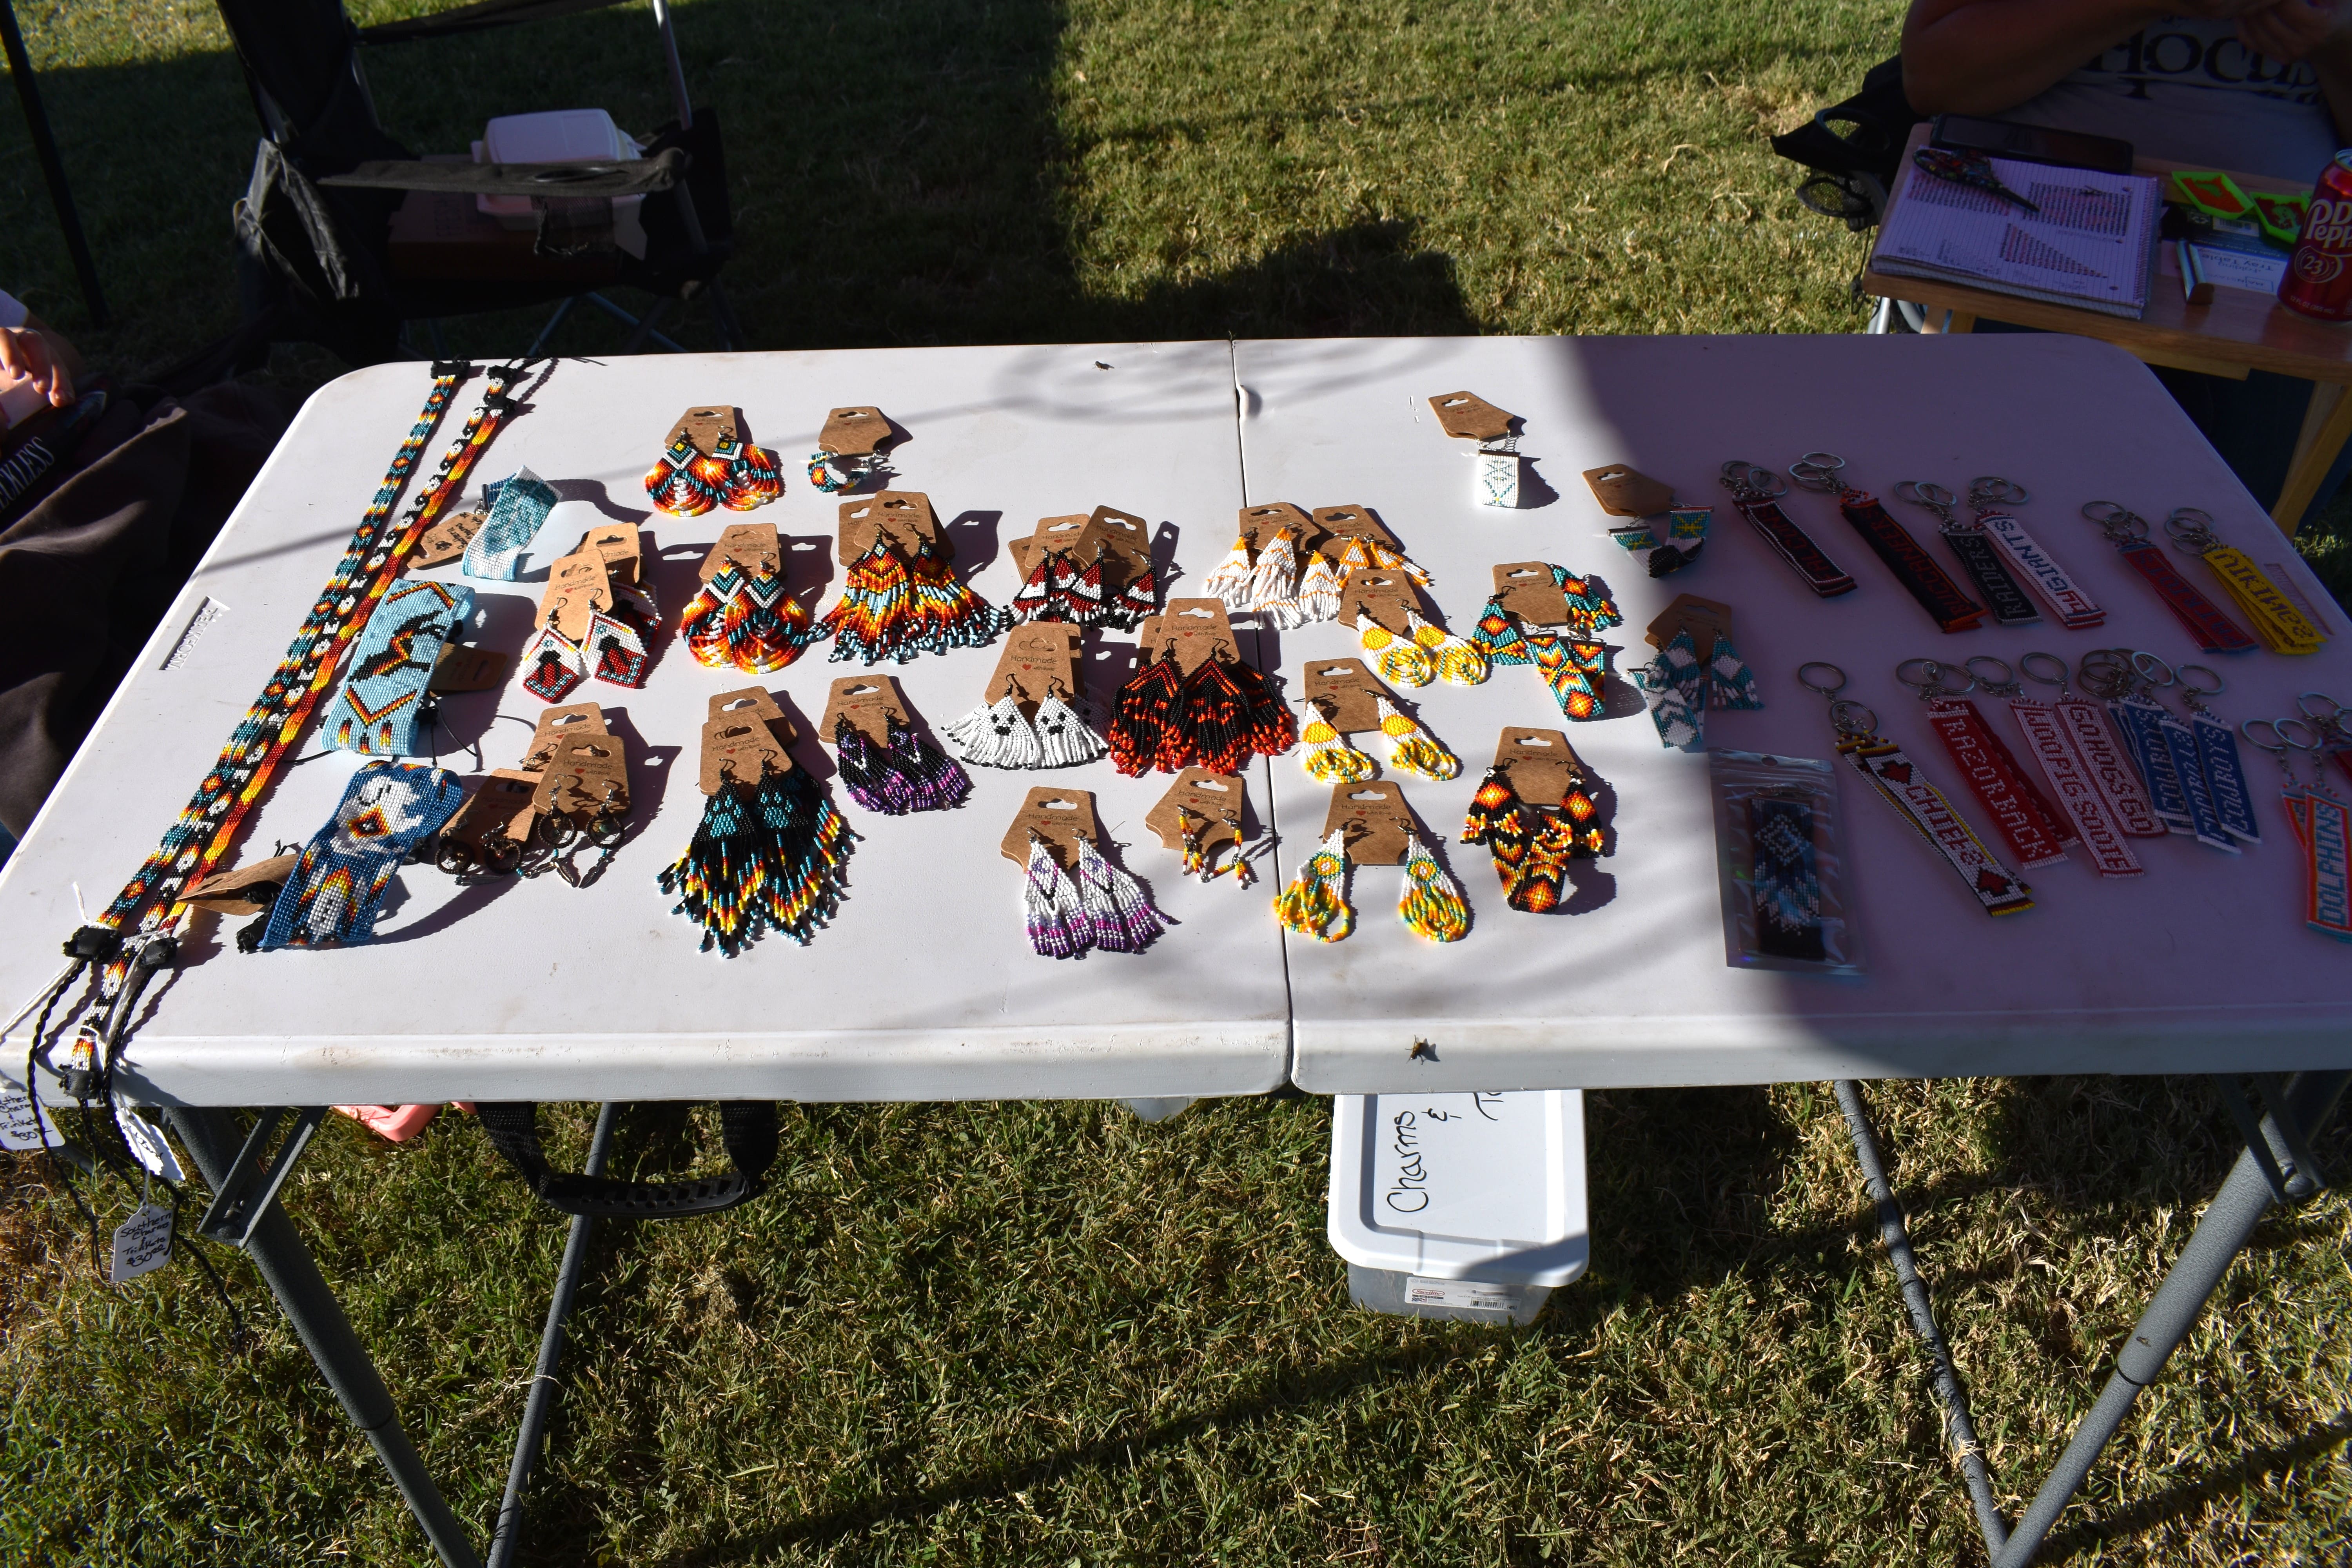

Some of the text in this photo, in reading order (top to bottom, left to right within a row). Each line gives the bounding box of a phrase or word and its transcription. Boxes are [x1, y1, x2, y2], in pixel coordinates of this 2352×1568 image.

[2330, 201, 2352, 225] D
[2304, 198, 2352, 248] Pepp
[2303, 255, 2323, 275] 23
[0, 437, 55, 510] ECKLESS
[1097, 525, 1138, 540] Handmade
[602, 549, 629, 558] ndmade
[1867, 506, 1976, 618] BUCCANEERS
[555, 575, 596, 590] Handmade
[1959, 534, 2028, 619] RAIDERS
[2132, 550, 2246, 648] PATRIOTS
[1011, 655, 1057, 664] Handmade
[1315, 677, 1360, 686] Handmade
[837, 695, 884, 706] Handmade
[545, 723, 592, 736] Handmade
[712, 736, 760, 751] Handmade
[1510, 749, 1558, 757] Handmade
[563, 759, 613, 769] Handmade
[1178, 789, 1227, 802] Handmade
[1942, 718, 2053, 860] RAZORBACK
[1028, 813, 1078, 821] Handmade
[2316, 802, 2346, 926] DOLPHINS
[0, 1103, 31, 1113] Charm
[0, 1117, 36, 1130] Trinket
[1387, 1111, 1429, 1212] Charms
[120, 1212, 172, 1238] Southern
[132, 1221, 169, 1240] Charms
[122, 1236, 166, 1255] Trinkets
